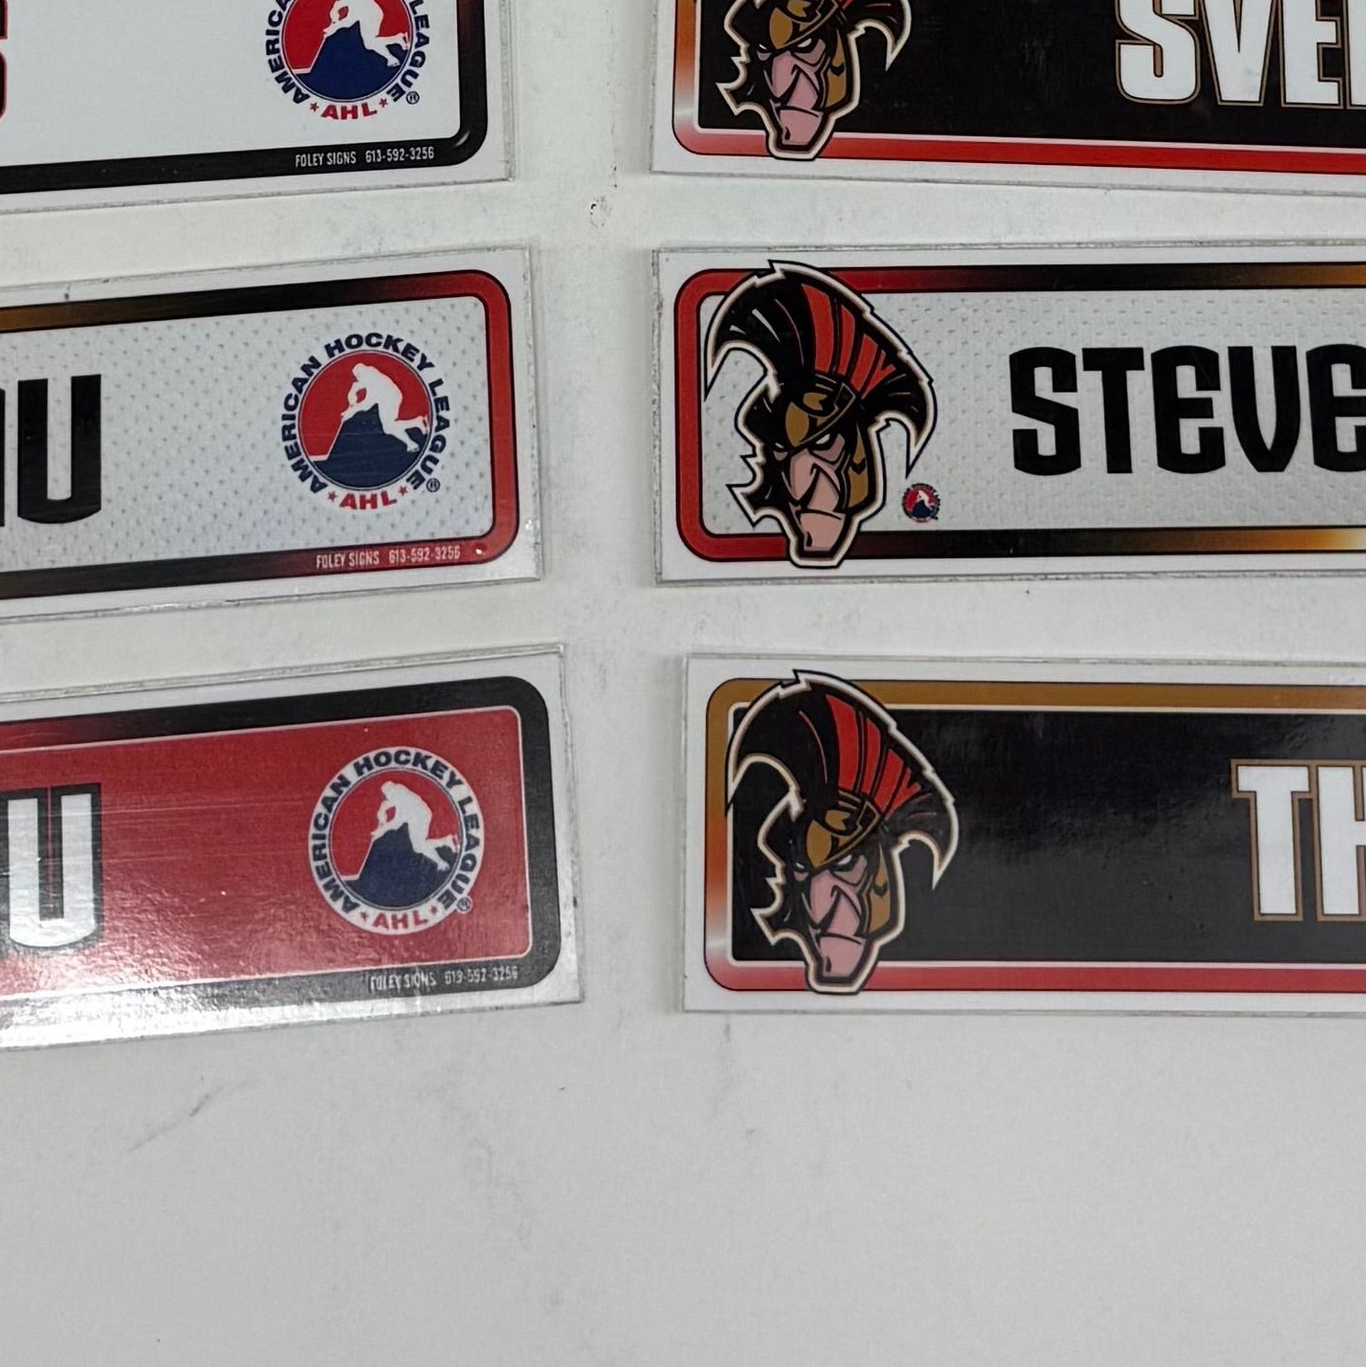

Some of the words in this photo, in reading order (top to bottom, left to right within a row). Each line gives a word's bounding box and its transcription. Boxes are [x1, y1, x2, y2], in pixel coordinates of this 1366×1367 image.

[321, 104, 377, 120] AHL
[295, 153, 324, 167] FOLEY
[327, 152, 356, 165] SIGNS
[281, 356, 328, 494] AMERICAN
[324, 332, 435, 370] HOCKEY
[406, 378, 451, 490] LEAGUE
[339, 494, 397, 510] AHL
[316, 555, 346, 568] FOLEY
[349, 551, 380, 567] SIGNS
[312, 779, 360, 915] AMERICAN
[352, 750, 463, 791] HOCKEY
[436, 796, 481, 910] LEAGUE
[373, 913, 430, 930] AHL
